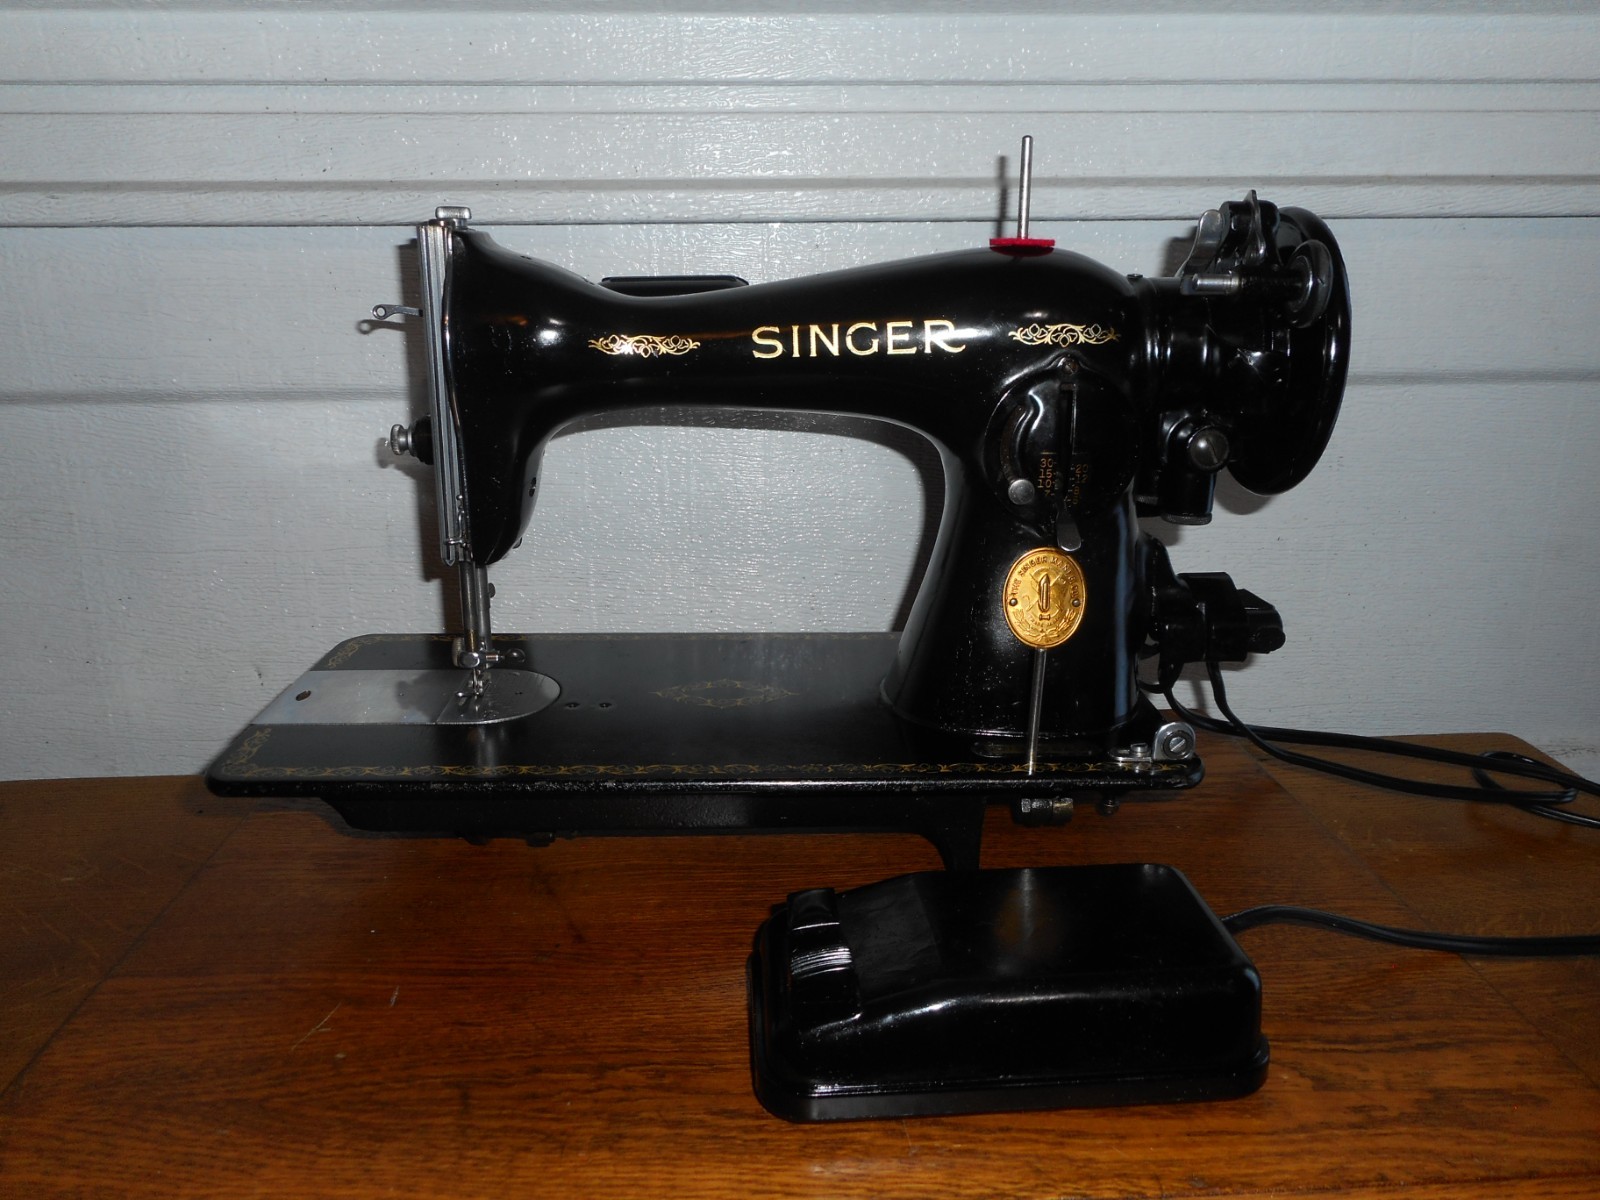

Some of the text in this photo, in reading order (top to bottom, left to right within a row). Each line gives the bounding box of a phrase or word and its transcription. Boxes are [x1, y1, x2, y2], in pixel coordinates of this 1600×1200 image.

[751, 319, 966, 359] SINGER
[1039, 458, 1054, 468] 30
[1038, 468, 1053, 479] 15
[1075, 464, 1088, 473] 20
[1037, 479, 1052, 488] 10
[1075, 474, 1088, 484] 12
